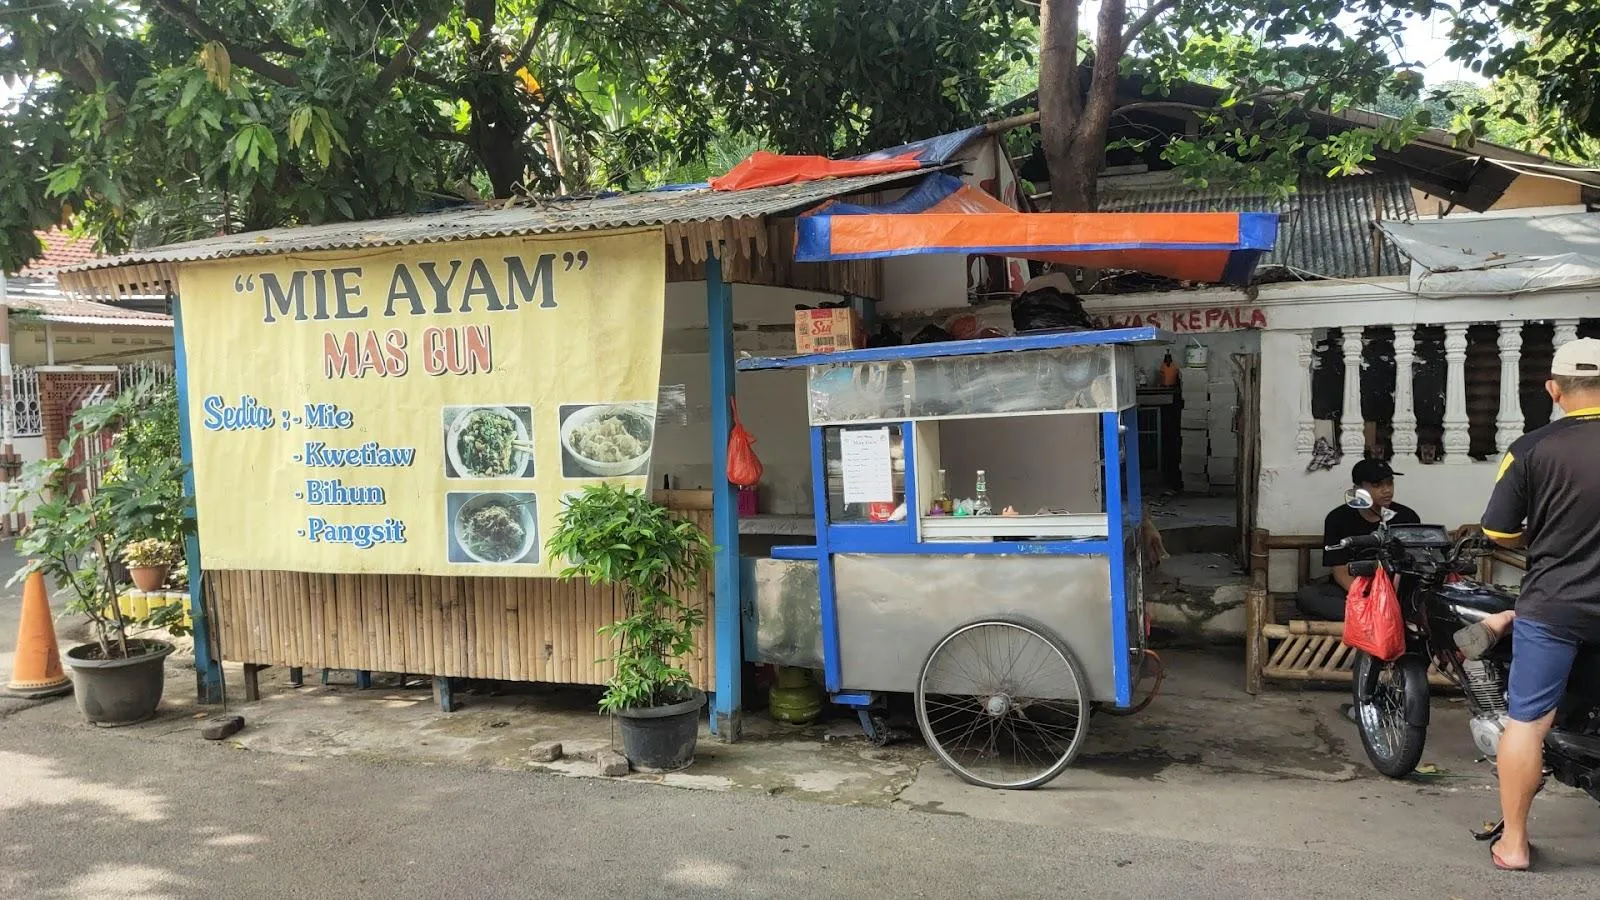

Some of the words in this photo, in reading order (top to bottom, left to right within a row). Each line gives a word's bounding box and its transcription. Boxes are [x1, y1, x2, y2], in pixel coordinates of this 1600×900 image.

[1172, 305, 1267, 332] KEPALA
[323, 327, 408, 379] MAS
[422, 324, 492, 376] GUN
[203, 395, 275, 431] Sedia
